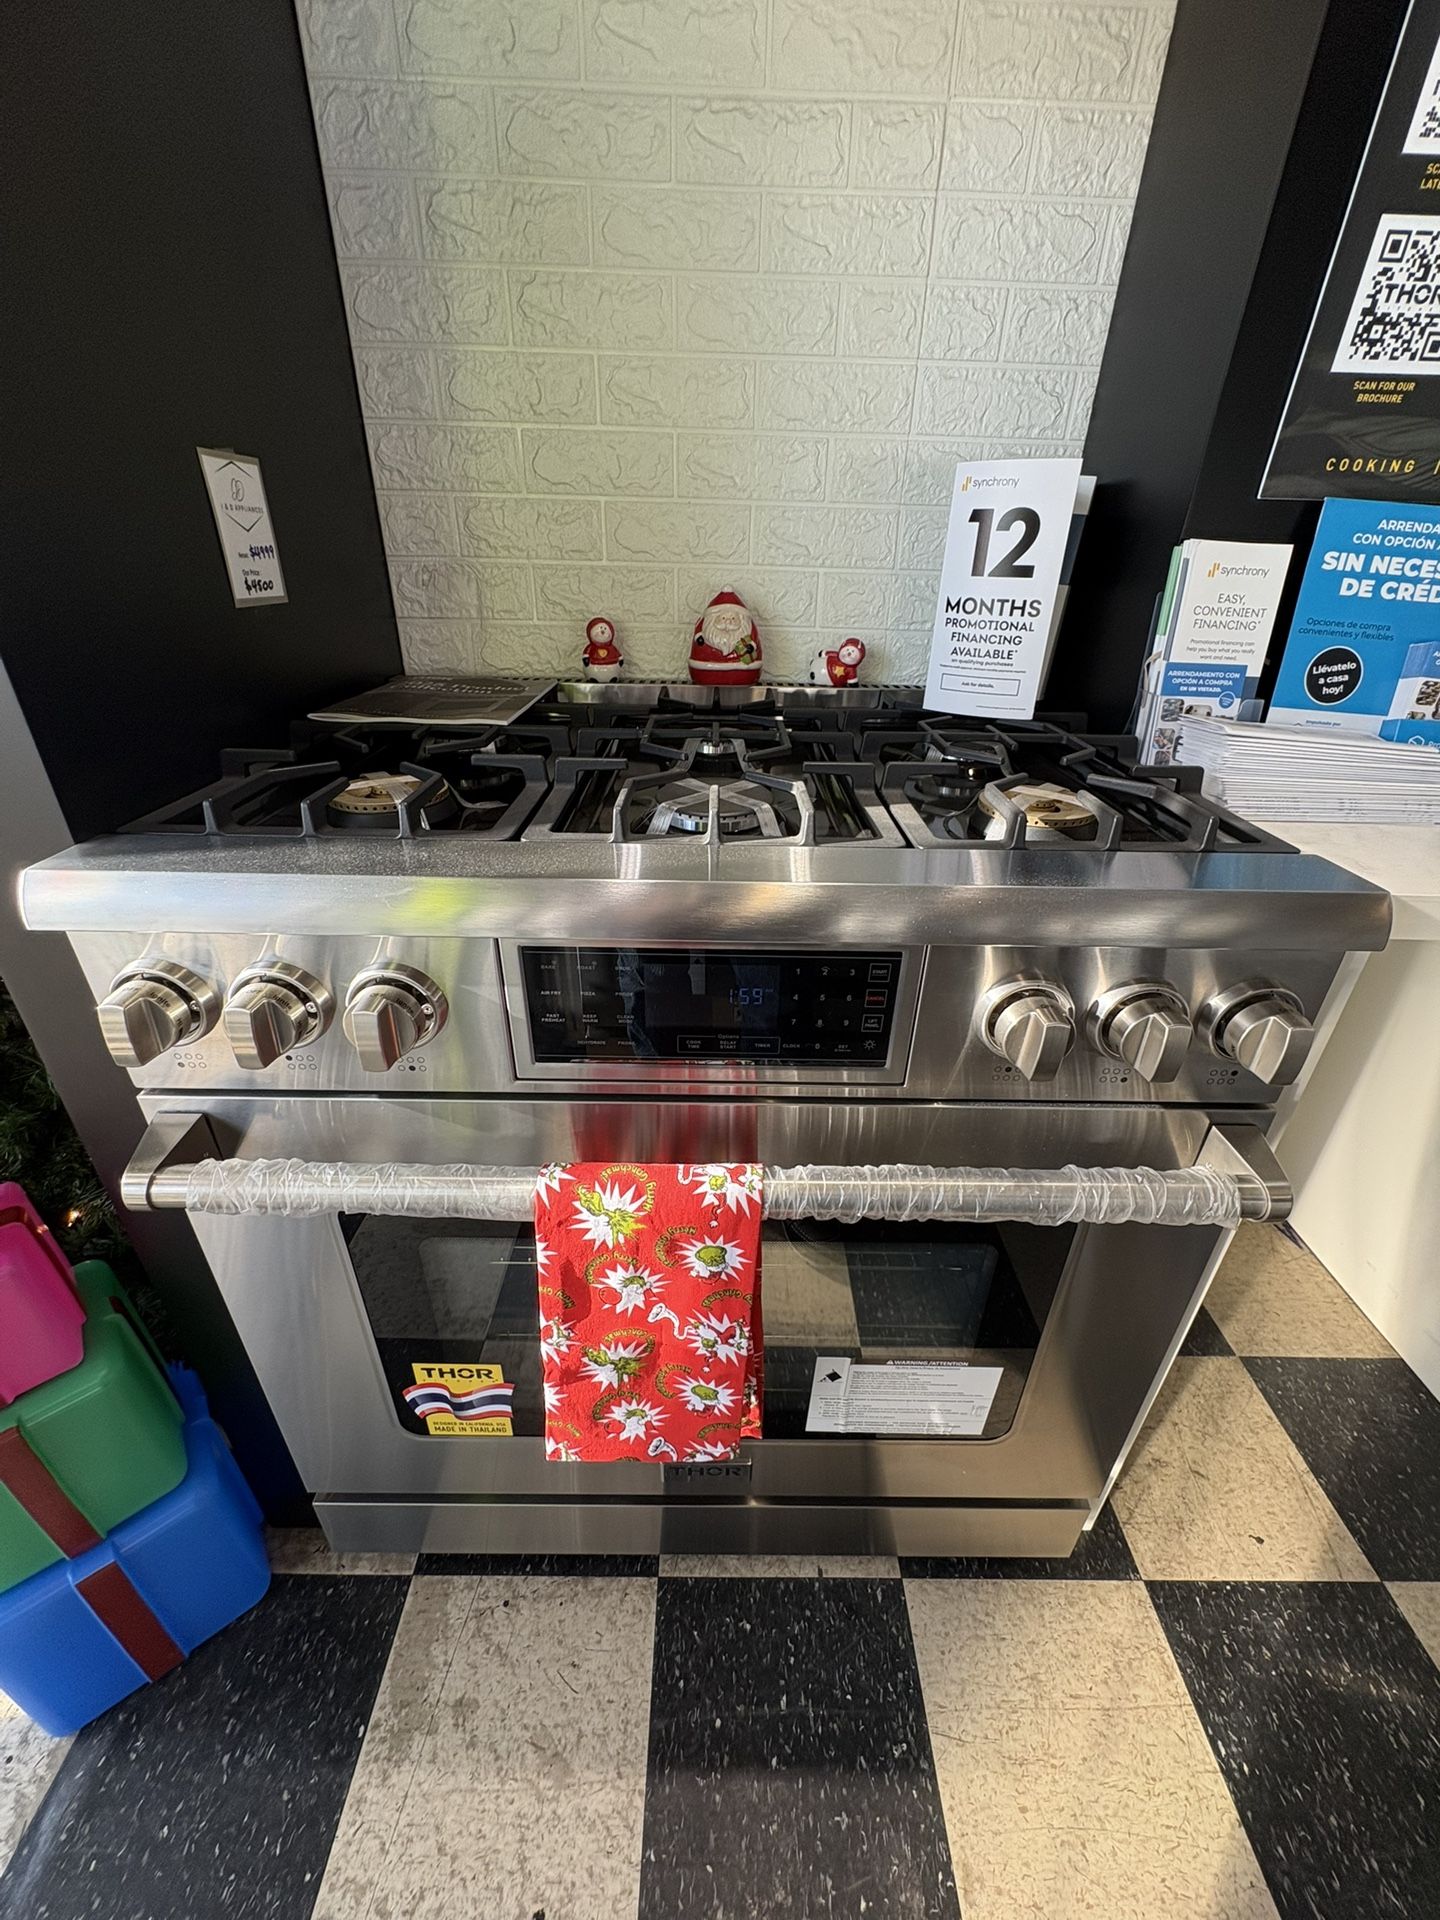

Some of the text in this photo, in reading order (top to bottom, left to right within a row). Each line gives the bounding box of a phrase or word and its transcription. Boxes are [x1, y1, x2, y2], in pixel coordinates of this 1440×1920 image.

[1353, 380, 1416, 392] SCAN FOR OUR
[1356, 393, 1404, 404] BROCHURE
[1325, 457, 1416, 473] COOKING
[972, 476, 1020, 489] synchrony
[968, 506, 1041, 578] 12
[1353, 532, 1436, 550] CON OPCIÓN
[249, 543, 275, 562] $4999
[1321, 551, 1366, 573] SIN
[1220, 565, 1270, 578] synchrony
[244, 576, 274, 596] $4500
[1339, 577, 1440, 604] DE CRÉD
[1217, 593, 1246, 605] EASY,
[945, 596, 1042, 618] MONTHS
[1193, 605, 1267, 618] CONVENIENT
[945, 617, 1035, 632] PROMOTIONAL
[1306, 617, 1391, 632] Opciones de compra
[951, 631, 1023, 646] FINANCING
[1298, 627, 1395, 642] convenientes y flexibles
[1190, 638, 1220, 646] Promotional
[958, 658, 984, 667] qualifying
[1312, 661, 1357, 675] Llévatelo
[1167, 670, 1225, 678] ARRENDAMIENTO
[1326, 674, 1349, 683] casa
[1171, 677, 1197, 685] OPCIÓN
[1204, 678, 1233, 686] COMPRA
[1322, 685, 1344, 695] hoy!
[795, 968, 801, 976] 1
[822, 968, 829, 976] 2
[849, 968, 856, 976] 3
[150, 991, 172, 1009] Ignite
[272, 994, 292, 1010] Ignite
[729, 987, 763, 1005] 1:59
[846, 994, 853, 1002] 6
[395, 998, 415, 1015] Ignite
[791, 1018, 797, 1026] 7
[843, 1019, 849, 1027] 9
[642, 1181, 657, 1212] Merry
[667, 1225, 697, 1238] Merry
[421, 1367, 494, 1379] THOR
[669, 1465, 741, 1476] THOR
